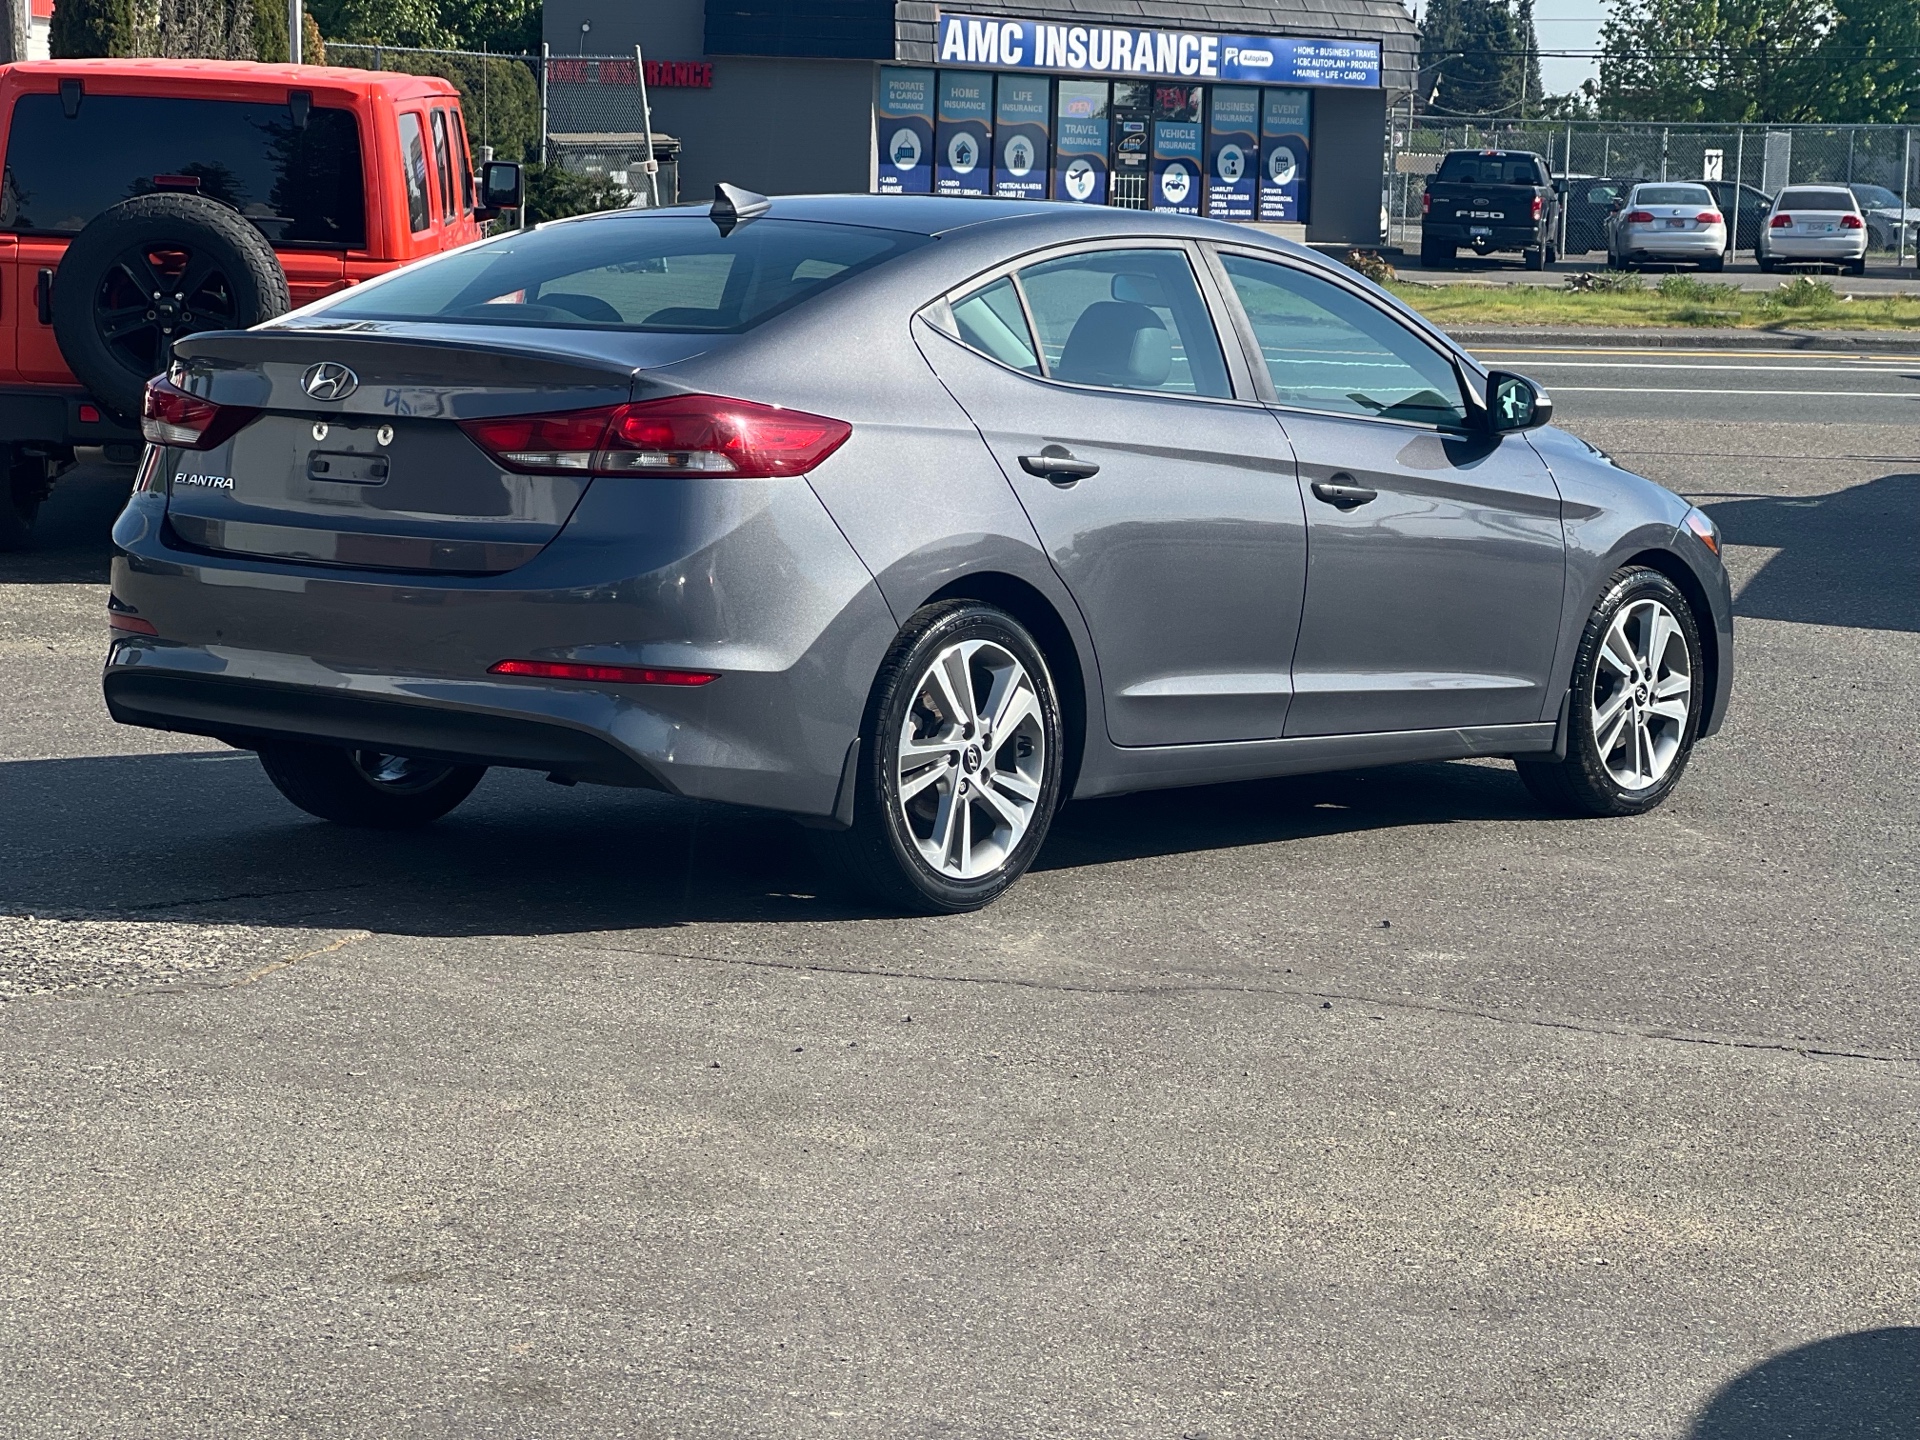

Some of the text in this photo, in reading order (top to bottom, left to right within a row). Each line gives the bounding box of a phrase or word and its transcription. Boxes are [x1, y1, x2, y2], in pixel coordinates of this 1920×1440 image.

[941, 19, 1218, 76] AMC INSURANCE
[1298, 46, 1378, 58] HOME BUSINESS TRAVEL
[1244, 54, 1269, 63] Autoplan
[1298, 57, 1378, 70] ICBC AUTOPLAN PRORATE
[1296, 68, 1366, 80] MARINE LIFE CARGO
[889, 81, 925, 91] PRORATE
[890, 91, 924, 100] & CARGO
[951, 88, 980, 98] HOME
[1013, 91, 1033, 102] LIFE
[889, 102, 924, 110] INSURANCE
[944, 101, 986, 110] INSURANCE
[1002, 104, 1043, 113] INSURANCE
[1214, 102, 1254, 112] BUSINESS
[1272, 104, 1300, 114] EVENT
[1215, 114, 1253, 123] INSURANCE
[1267, 116, 1304, 126] INSURANCE
[1065, 124, 1098, 135] TRAVEL
[1160, 129, 1196, 139] VEHICLE
[1062, 137, 1102, 146] INSURANCE
[1158, 141, 1196, 150] INSURANCE
[1456, 210, 1504, 218] F-150
[174, 472, 234, 490] ELANTRA
